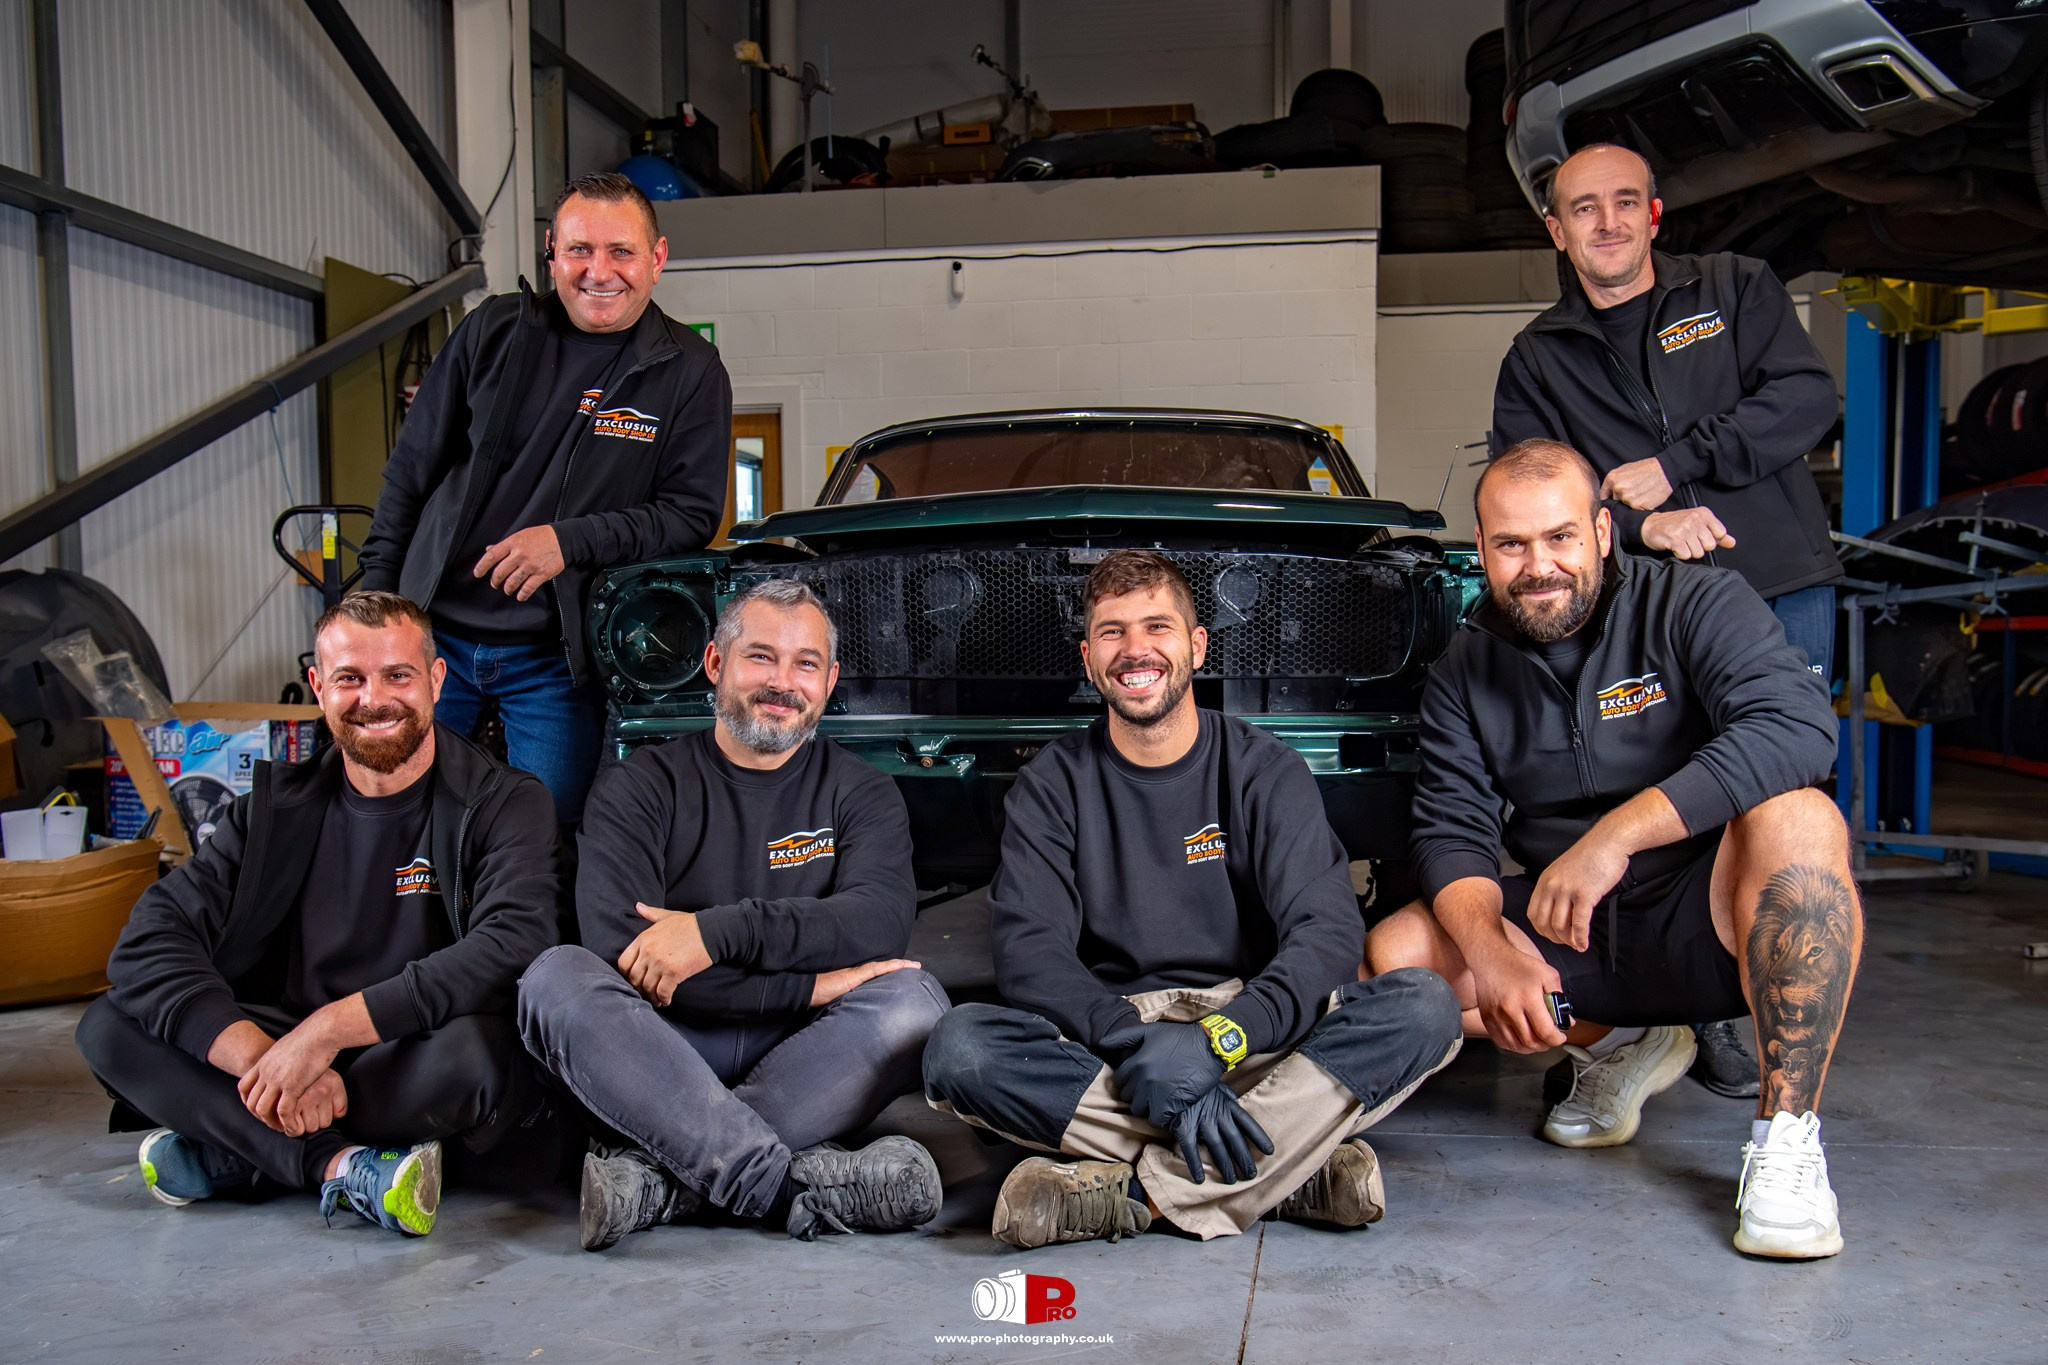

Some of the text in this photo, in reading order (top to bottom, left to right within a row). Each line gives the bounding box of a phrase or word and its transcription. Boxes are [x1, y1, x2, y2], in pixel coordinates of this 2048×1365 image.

[1661, 316, 1722, 347] EXCLUSIVE
[1664, 341, 1681, 351] AUTO
[1698, 328, 1713, 336] SHOP
[1714, 322, 1724, 331] LTD
[595, 419, 658, 434] EXCLUSIVE
[630, 430, 646, 438] SHOP
[1600, 682, 1662, 710] EXCLUIVE
[1601, 707, 1620, 717] AUTO
[1621, 702, 1641, 713] BODY
[1653, 690, 1666, 700] LTD
[189, 730, 231, 755] air
[239, 753, 251, 769] 3
[769, 838, 834, 860] EXCLUSIVE
[770, 857, 789, 865] AUTO
[790, 855, 808, 863] BODY
[808, 848, 823, 858] SHOP
[1187, 848, 1222, 861] AUTO BODY
